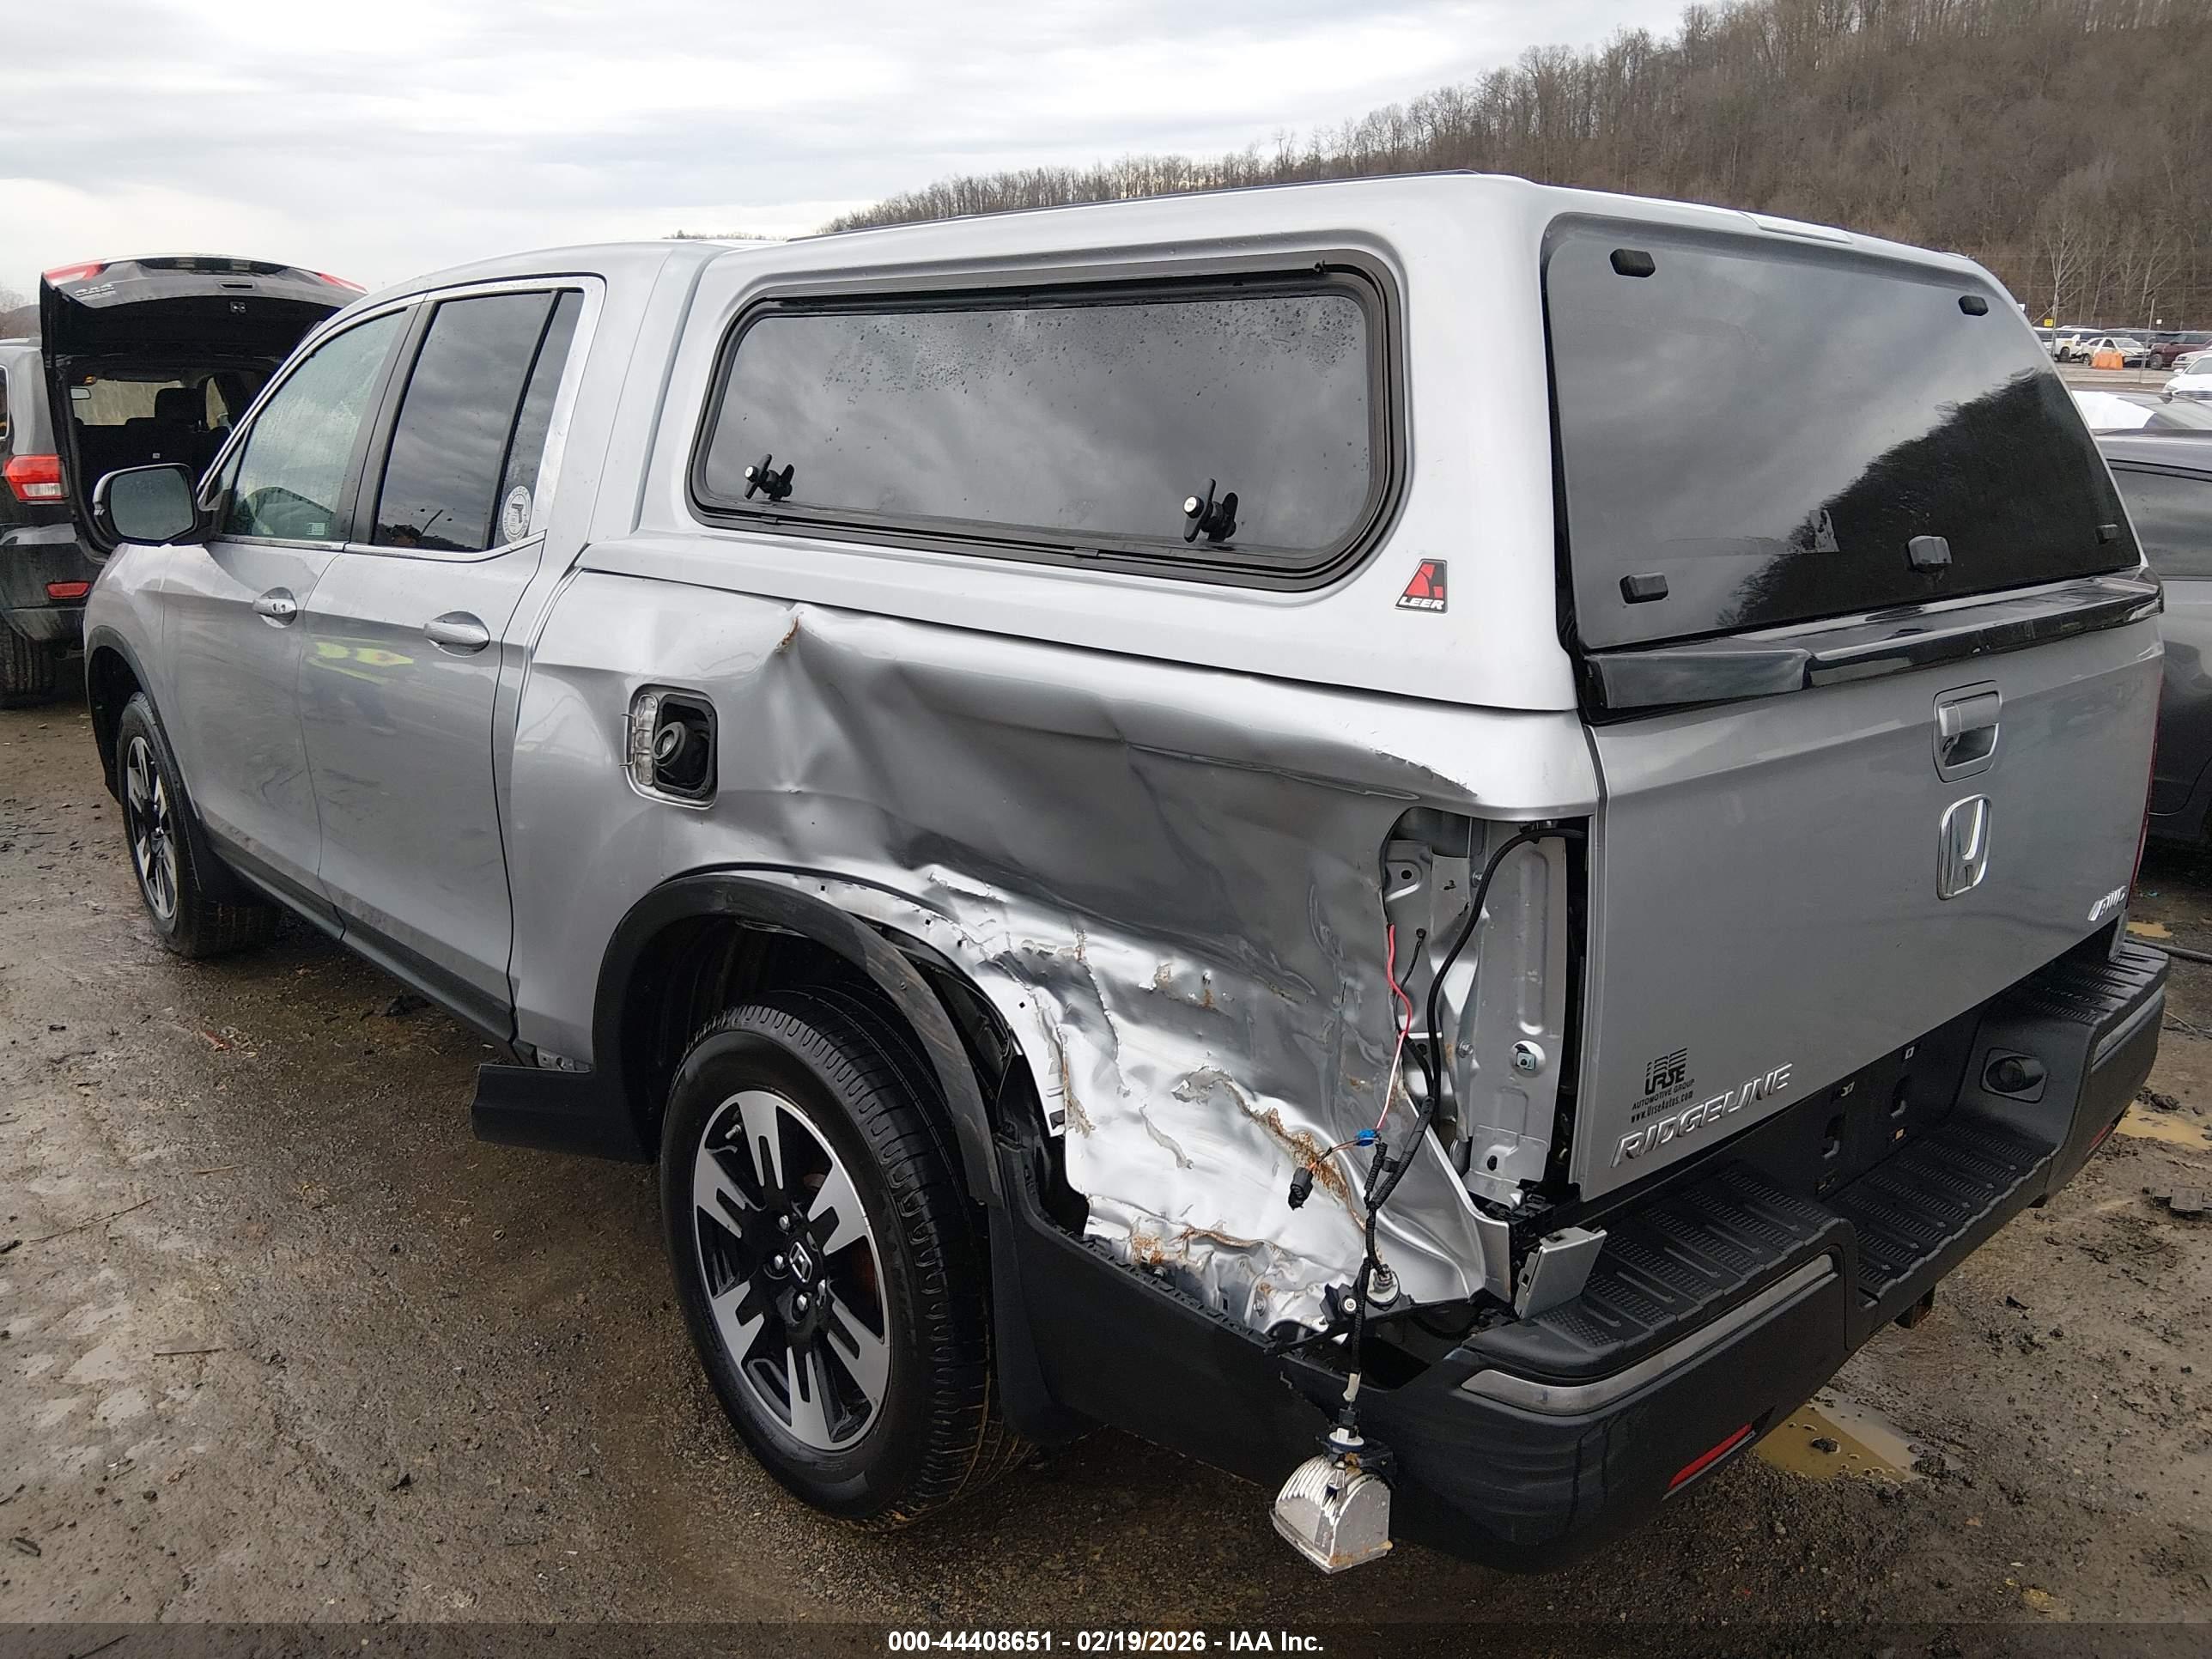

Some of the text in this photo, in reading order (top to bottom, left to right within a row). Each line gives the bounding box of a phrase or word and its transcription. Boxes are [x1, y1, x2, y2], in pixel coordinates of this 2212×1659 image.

[1398, 596, 1444, 611] LEER
[1632, 1079, 1695, 1110] AUTOMOTIVE GROUP
[1610, 1061, 1792, 1169] RIDGELINE
